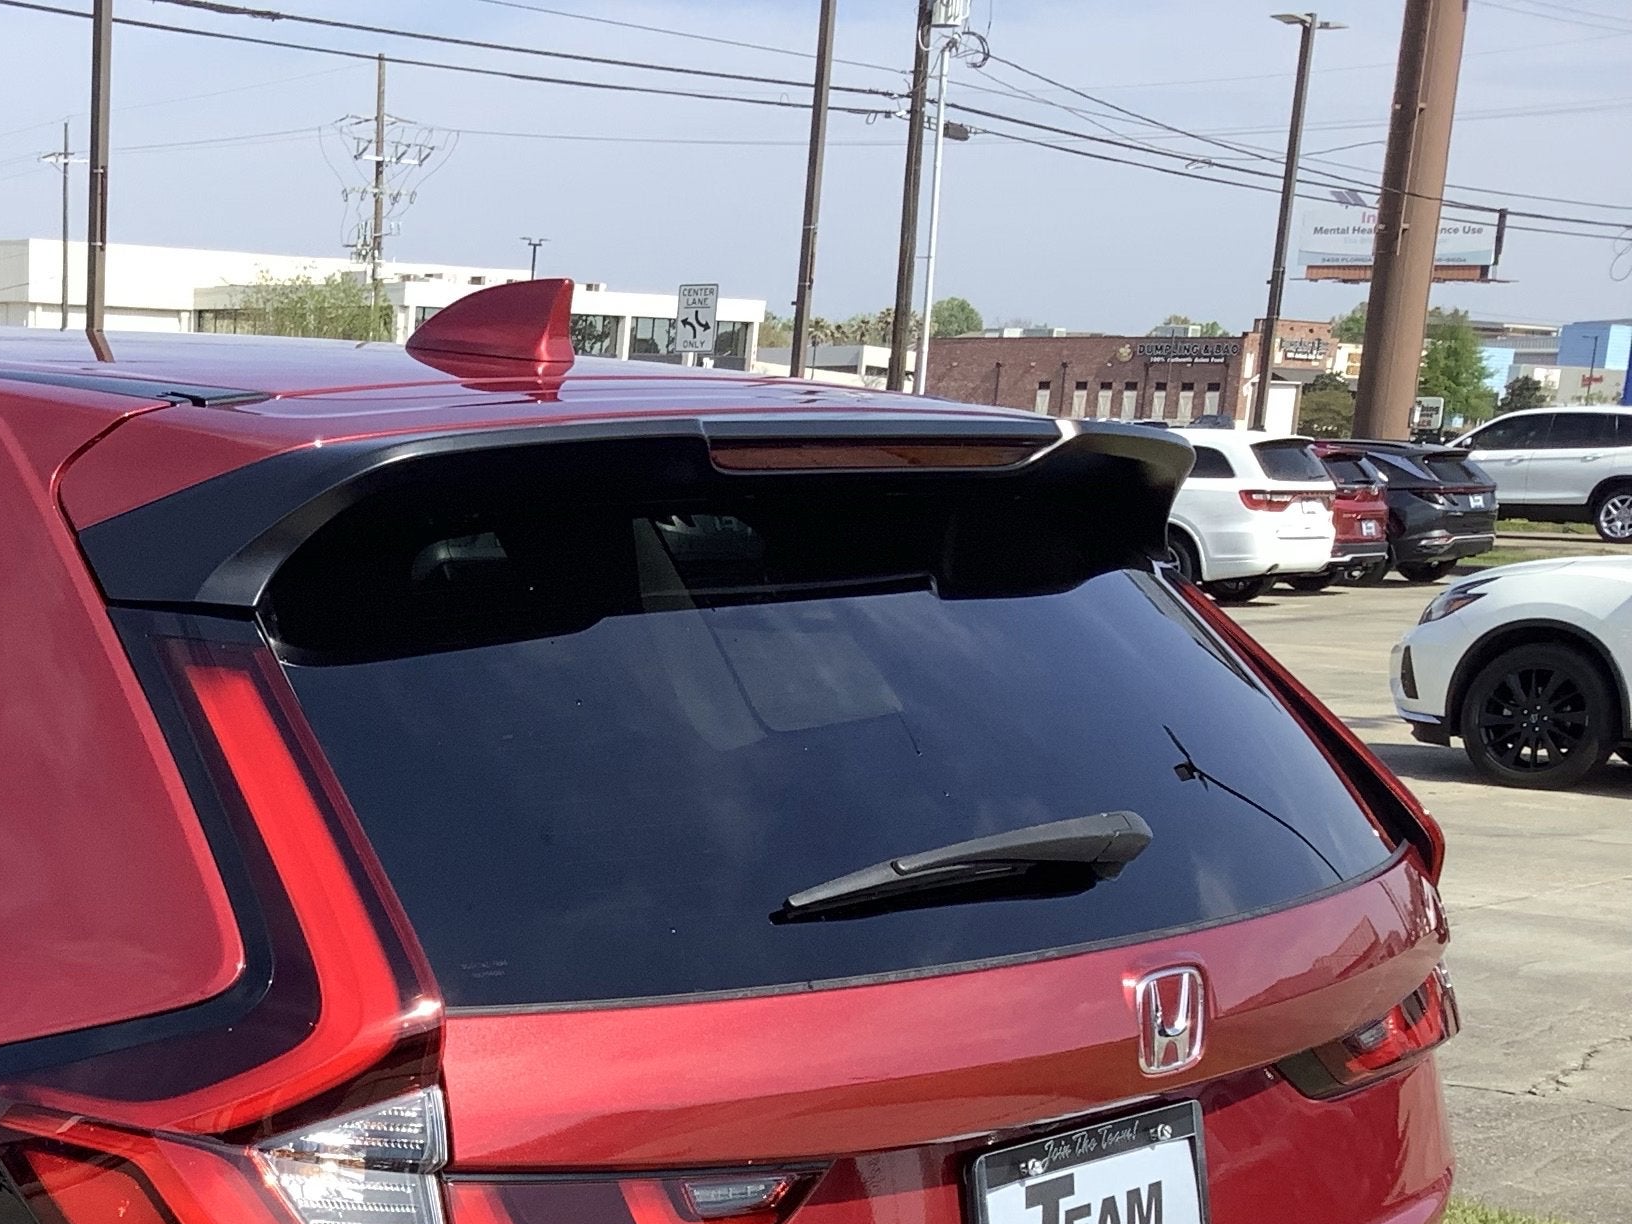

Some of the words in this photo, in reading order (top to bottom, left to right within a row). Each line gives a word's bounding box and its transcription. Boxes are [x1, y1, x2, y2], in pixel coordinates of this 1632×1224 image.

[1313, 226, 1350, 236] Mental
[1462, 225, 1484, 235] Use
[682, 287, 715, 297] CENTER
[686, 297, 709, 306] LANE
[682, 339, 705, 349] ONLY
[1137, 343, 1199, 356] DUMPLING
[1201, 343, 1212, 355] &
[1214, 343, 1240, 356] BAO
[1041, 1139, 1072, 1170] Join
[1072, 1130, 1098, 1158] The
[1098, 1120, 1140, 1149] Team!
